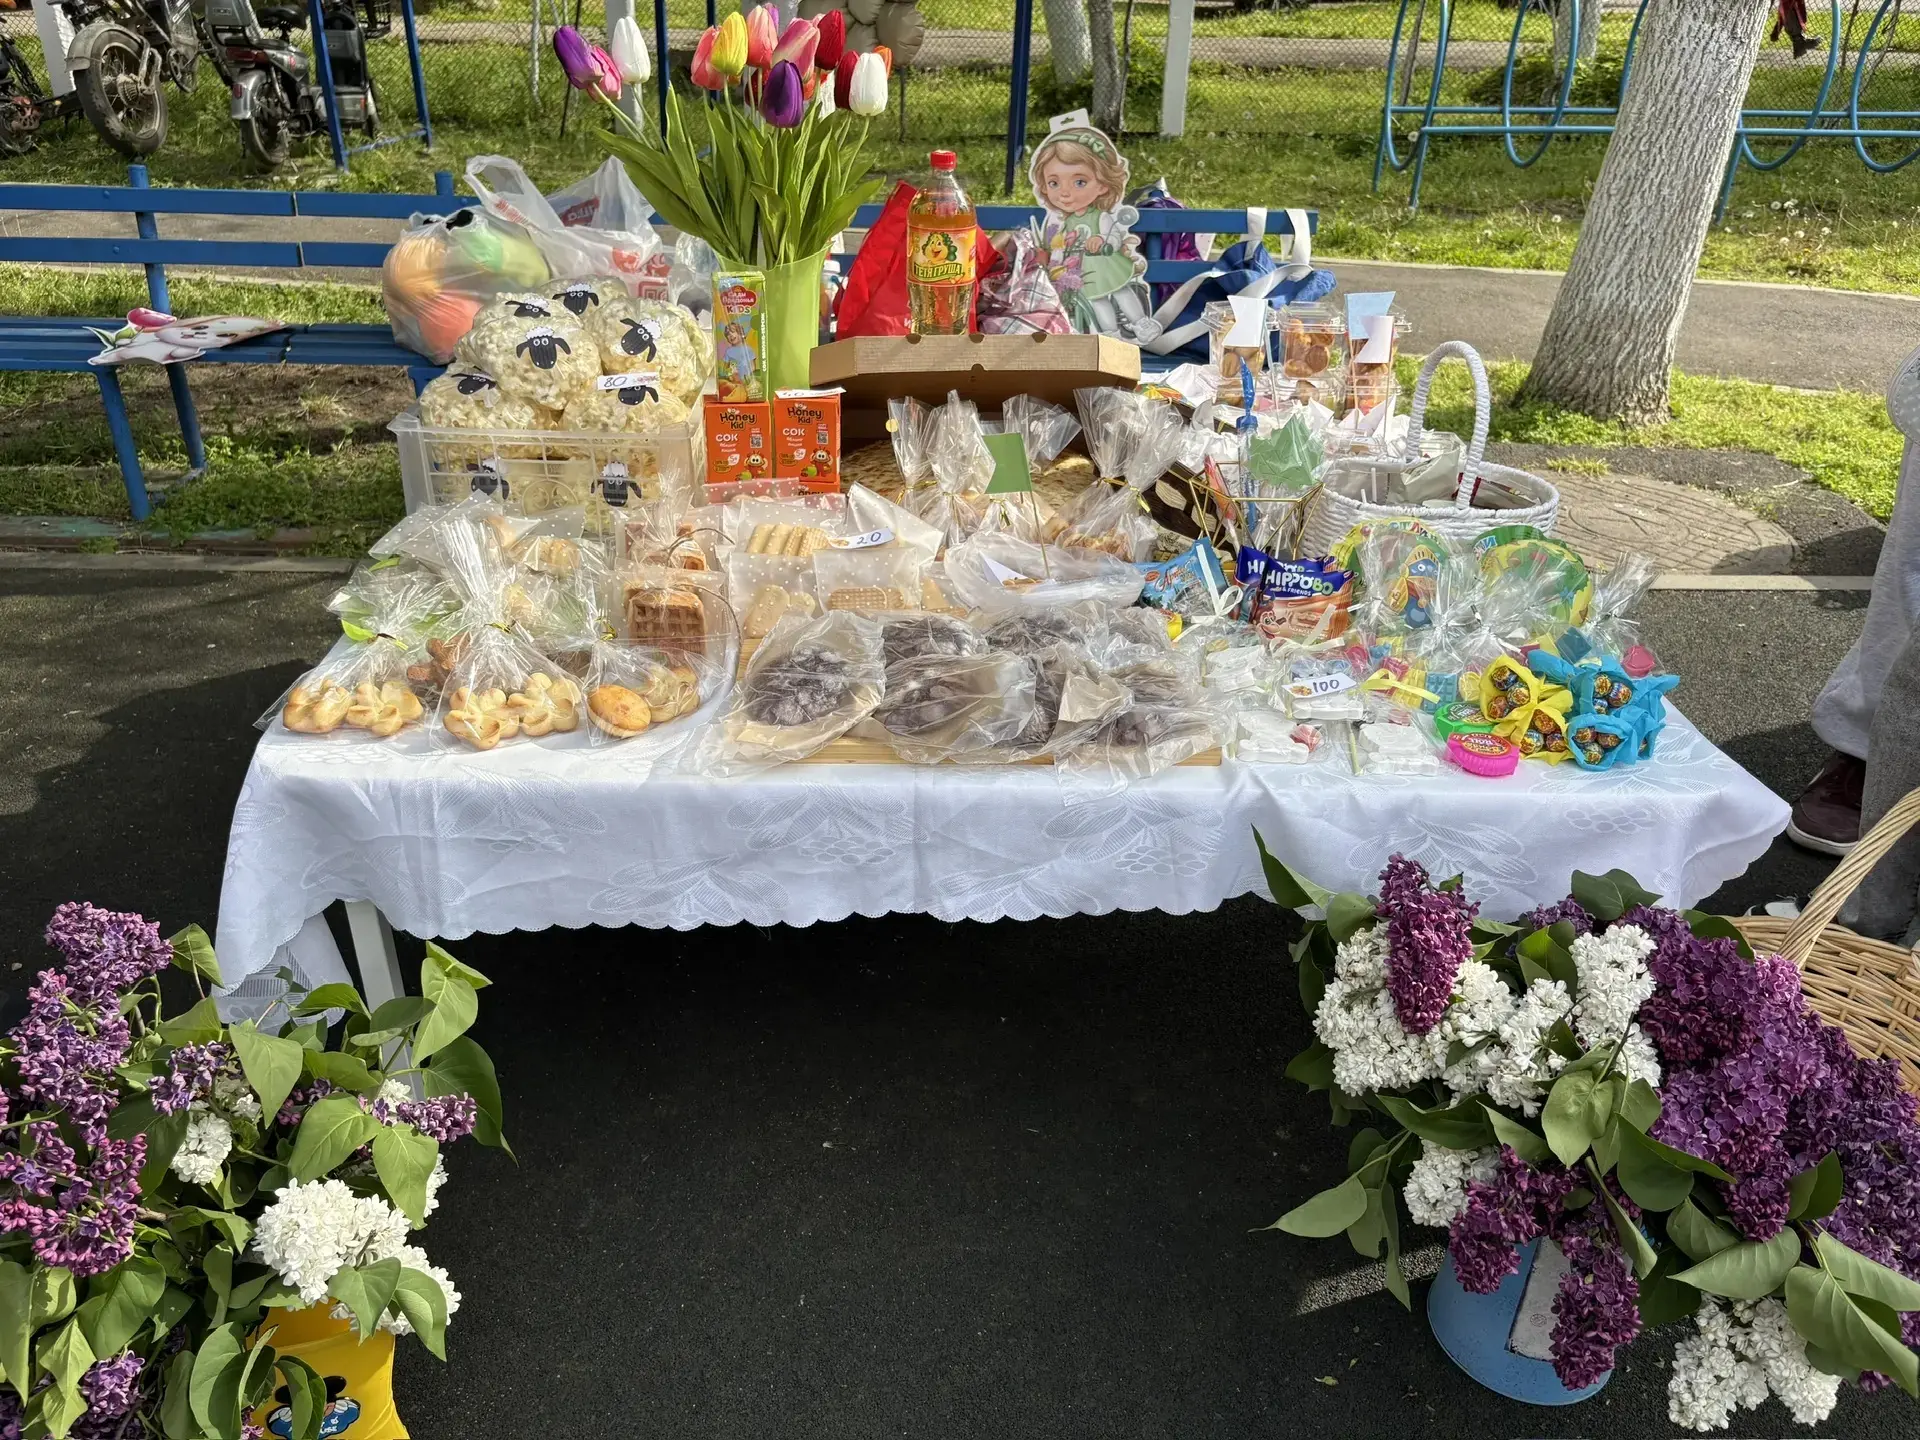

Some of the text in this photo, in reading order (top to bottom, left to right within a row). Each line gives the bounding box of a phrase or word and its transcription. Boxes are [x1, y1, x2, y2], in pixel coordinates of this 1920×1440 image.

[933, 263, 961, 277] ГРУША
[603, 376, 628, 388] 80
[719, 411, 756, 424] Honey
[787, 406, 822, 420] Honey
[730, 421, 744, 429] Kid
[797, 415, 811, 424] Kid
[715, 433, 739, 442] СОК
[782, 427, 805, 437] СОК
[856, 531, 882, 546] 20
[1265, 569, 1334, 596] HIPPOBO
[1287, 587, 1312, 596] FRIENDS
[1312, 679, 1340, 693] 100
